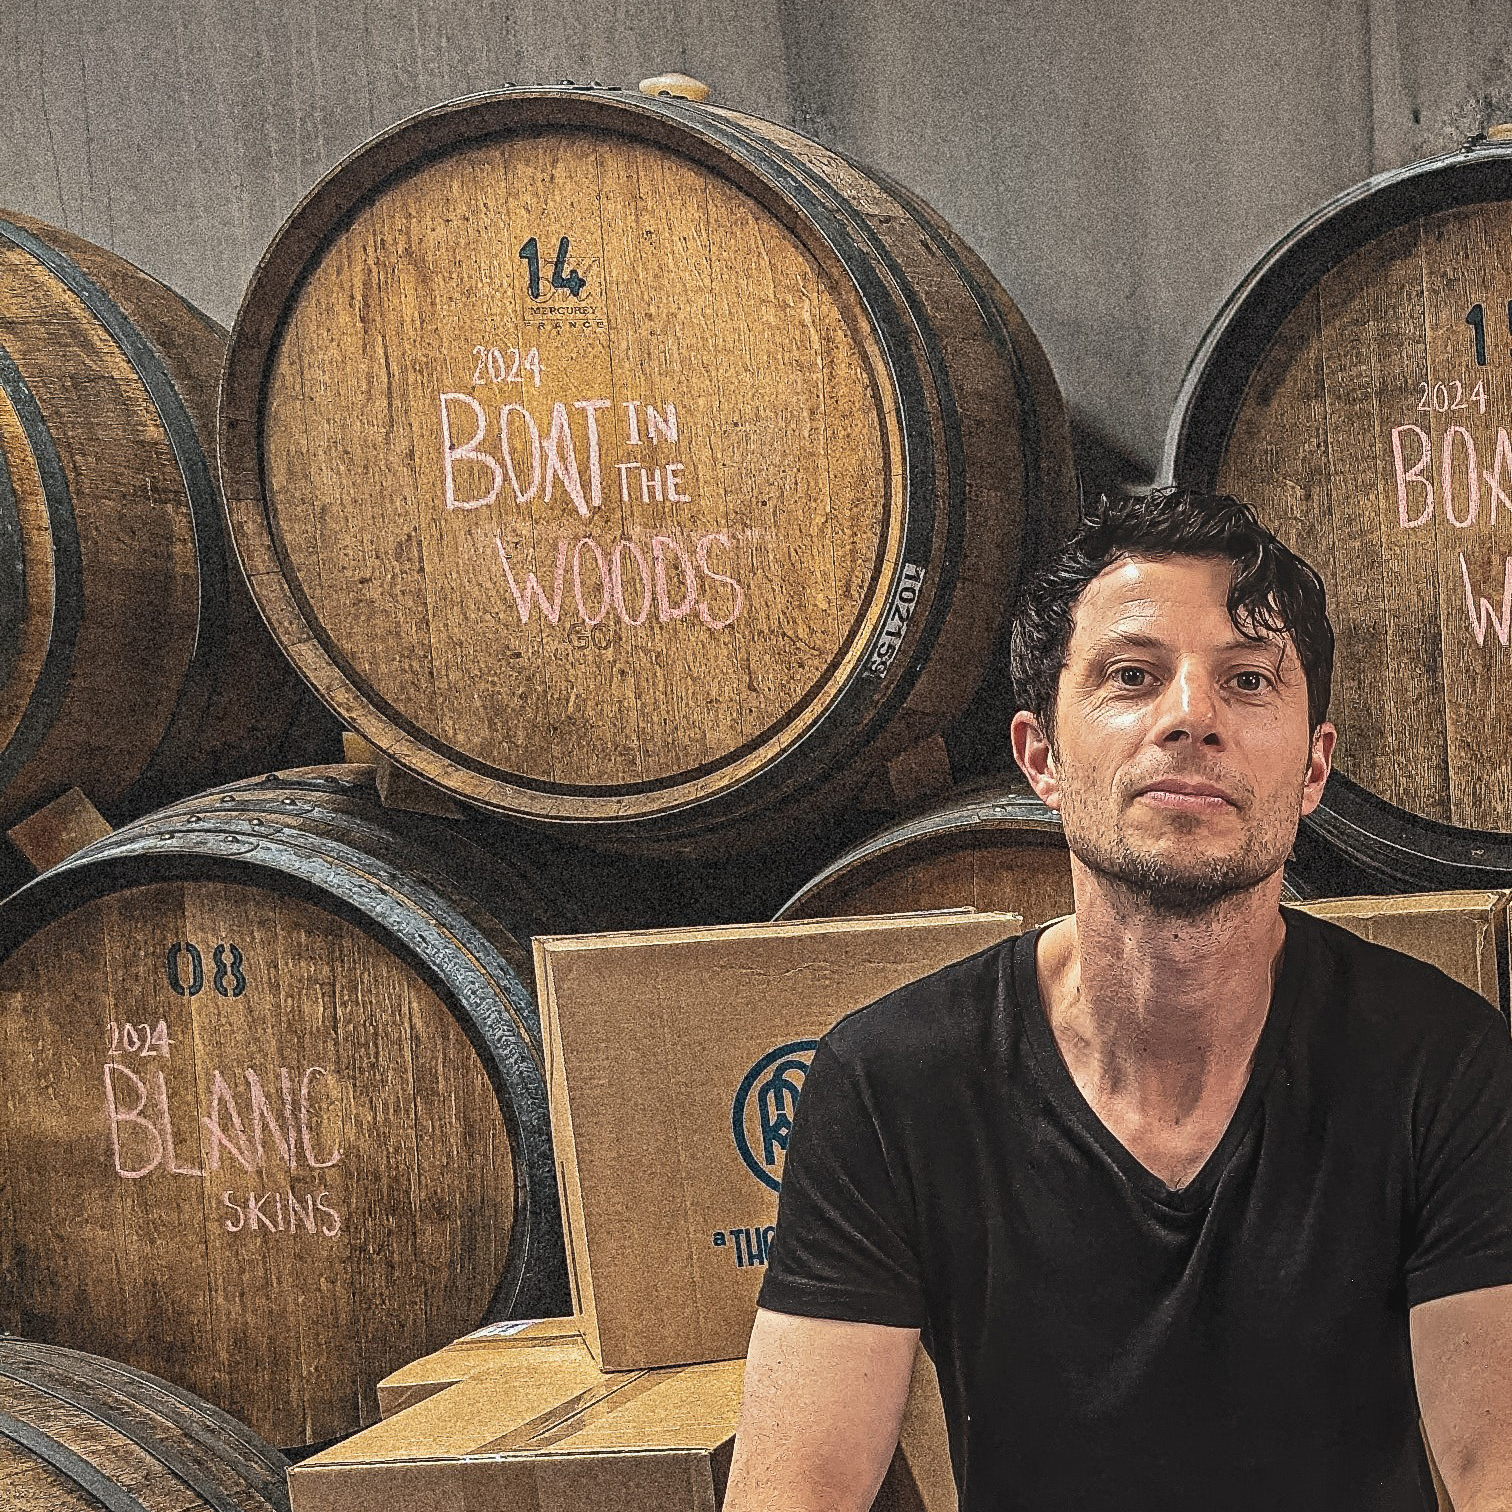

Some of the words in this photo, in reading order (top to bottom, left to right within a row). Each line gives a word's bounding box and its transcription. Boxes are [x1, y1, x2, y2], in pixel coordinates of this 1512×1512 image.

[519, 236, 587, 299] 14
[528, 305, 598, 316] MERCUREY
[473, 345, 546, 388] 2024
[1416, 379, 1488, 415] 2024
[439, 392, 612, 518] BOAT
[622, 400, 679, 446] IN
[614, 461, 693, 504] THE
[494, 530, 745, 629] WOODS
[166, 942, 247, 998] 08
[105, 1019, 176, 1059] 2024
[103, 1062, 344, 1179] BLANC
[222, 1189, 342, 1238] SKINS
